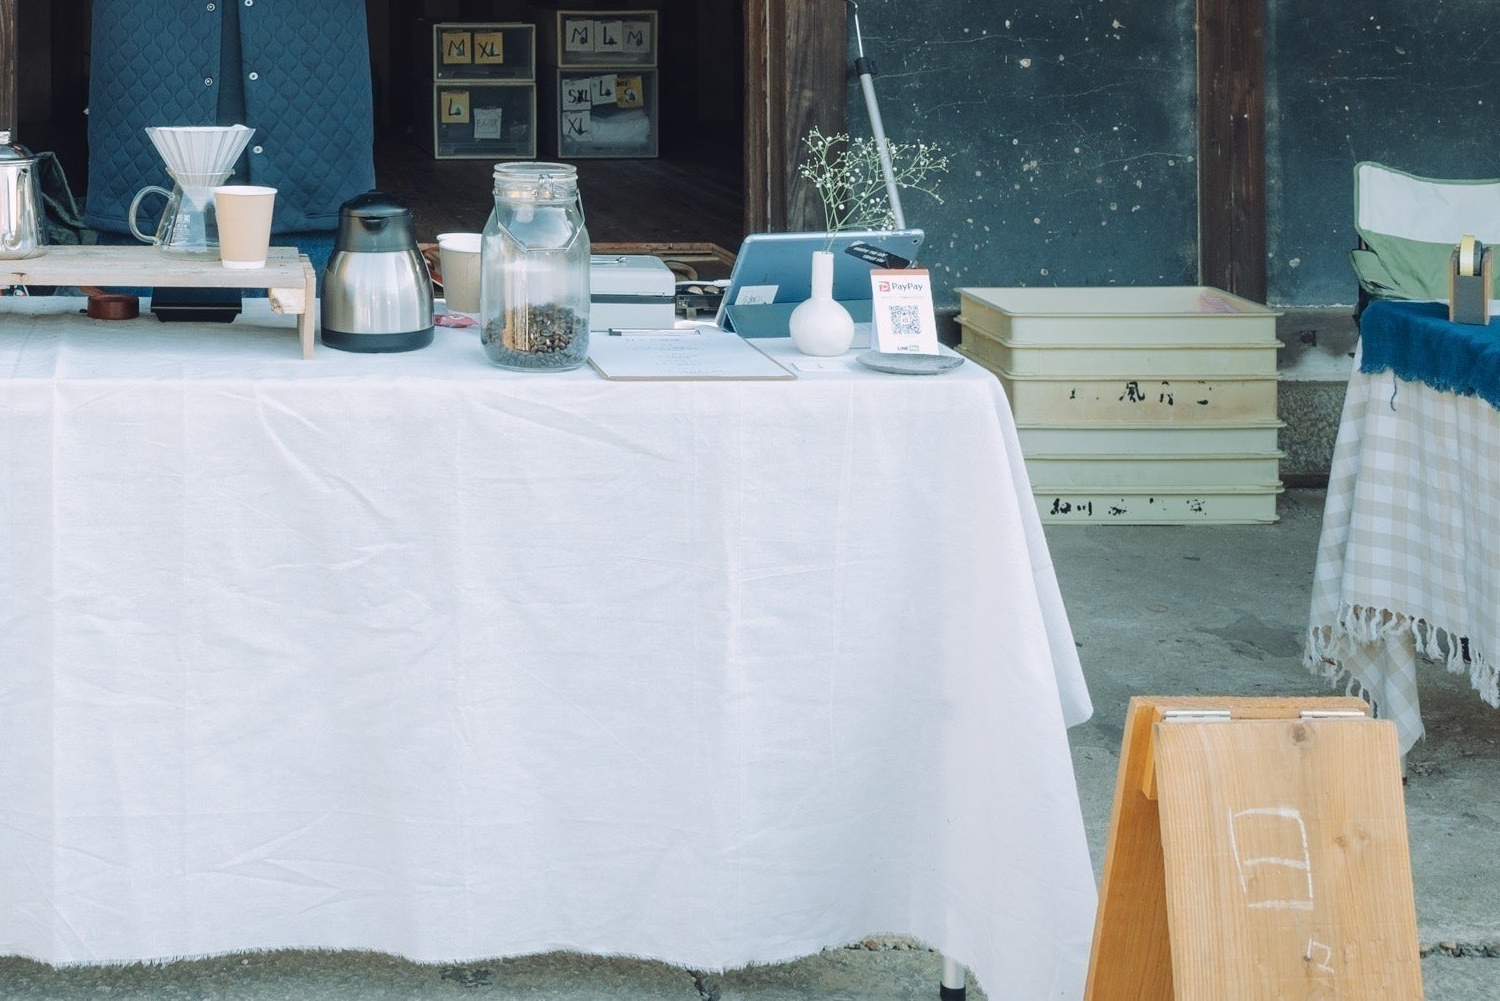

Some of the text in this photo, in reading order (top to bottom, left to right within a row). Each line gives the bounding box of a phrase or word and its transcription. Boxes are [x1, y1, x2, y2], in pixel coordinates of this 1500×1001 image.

[571, 26, 588, 44] M
[603, 26, 617, 45] L
[448, 39, 465, 57] M
[478, 41, 500, 58] XL
[448, 98, 462, 116] L
[568, 118, 589, 135] XL
[891, 282, 924, 292] PayPay
